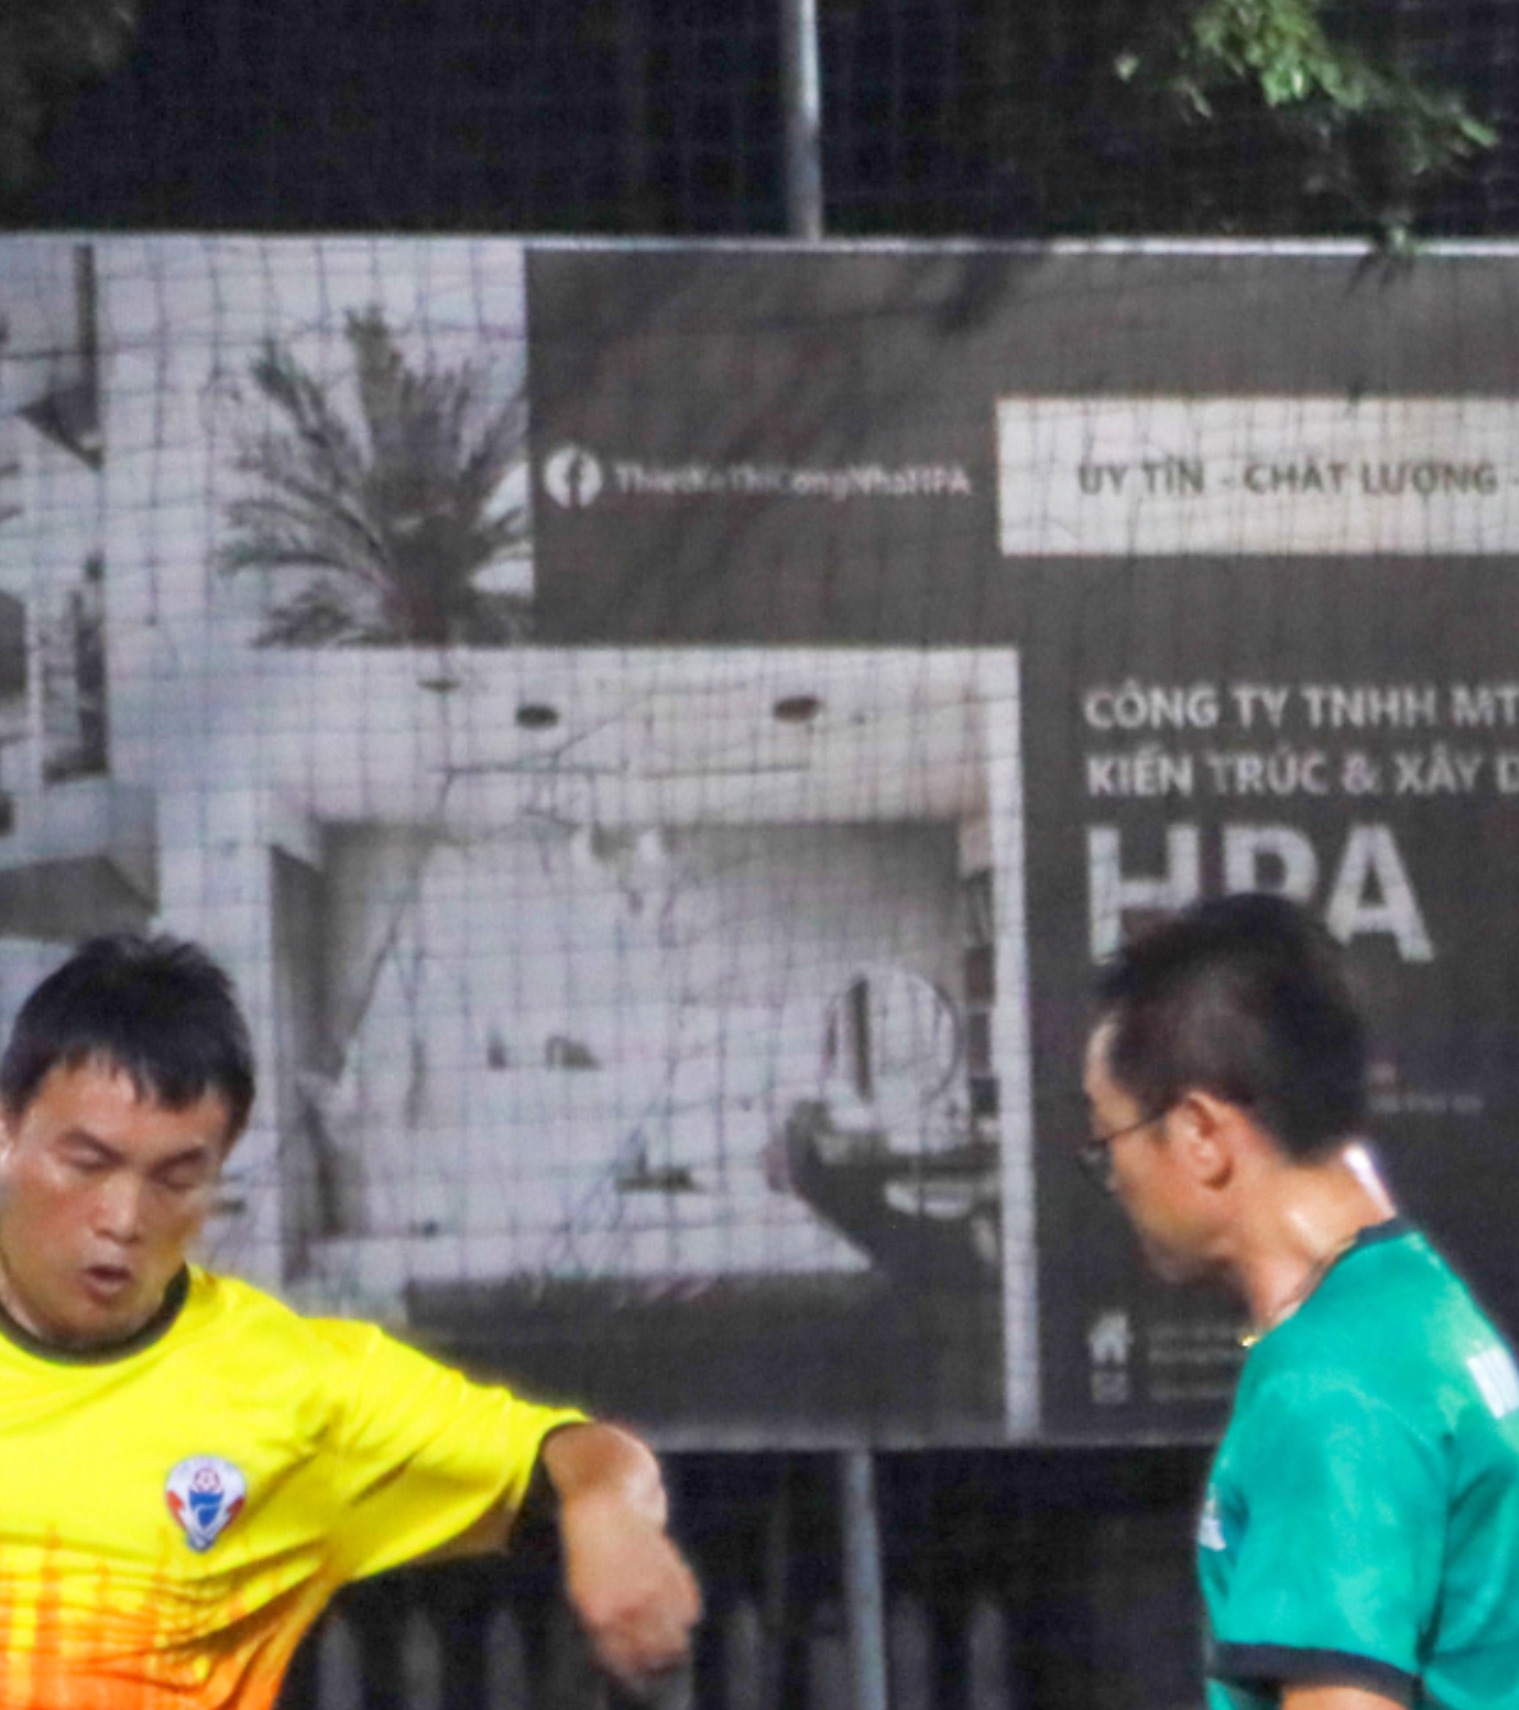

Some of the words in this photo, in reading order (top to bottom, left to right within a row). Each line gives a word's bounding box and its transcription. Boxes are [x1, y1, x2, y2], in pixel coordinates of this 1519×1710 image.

[1078, 462, 1128, 496] UY
[1084, 676, 1219, 729] CÔNG
[1230, 684, 1289, 728] TY
[1301, 684, 1436, 728] TNHH
[1087, 742, 1194, 798] KIẾN
[1207, 744, 1329, 797] TRÚC
[1340, 751, 1380, 796] &
[1393, 742, 1483, 796] XÂY
[1086, 821, 1435, 965] HPA
